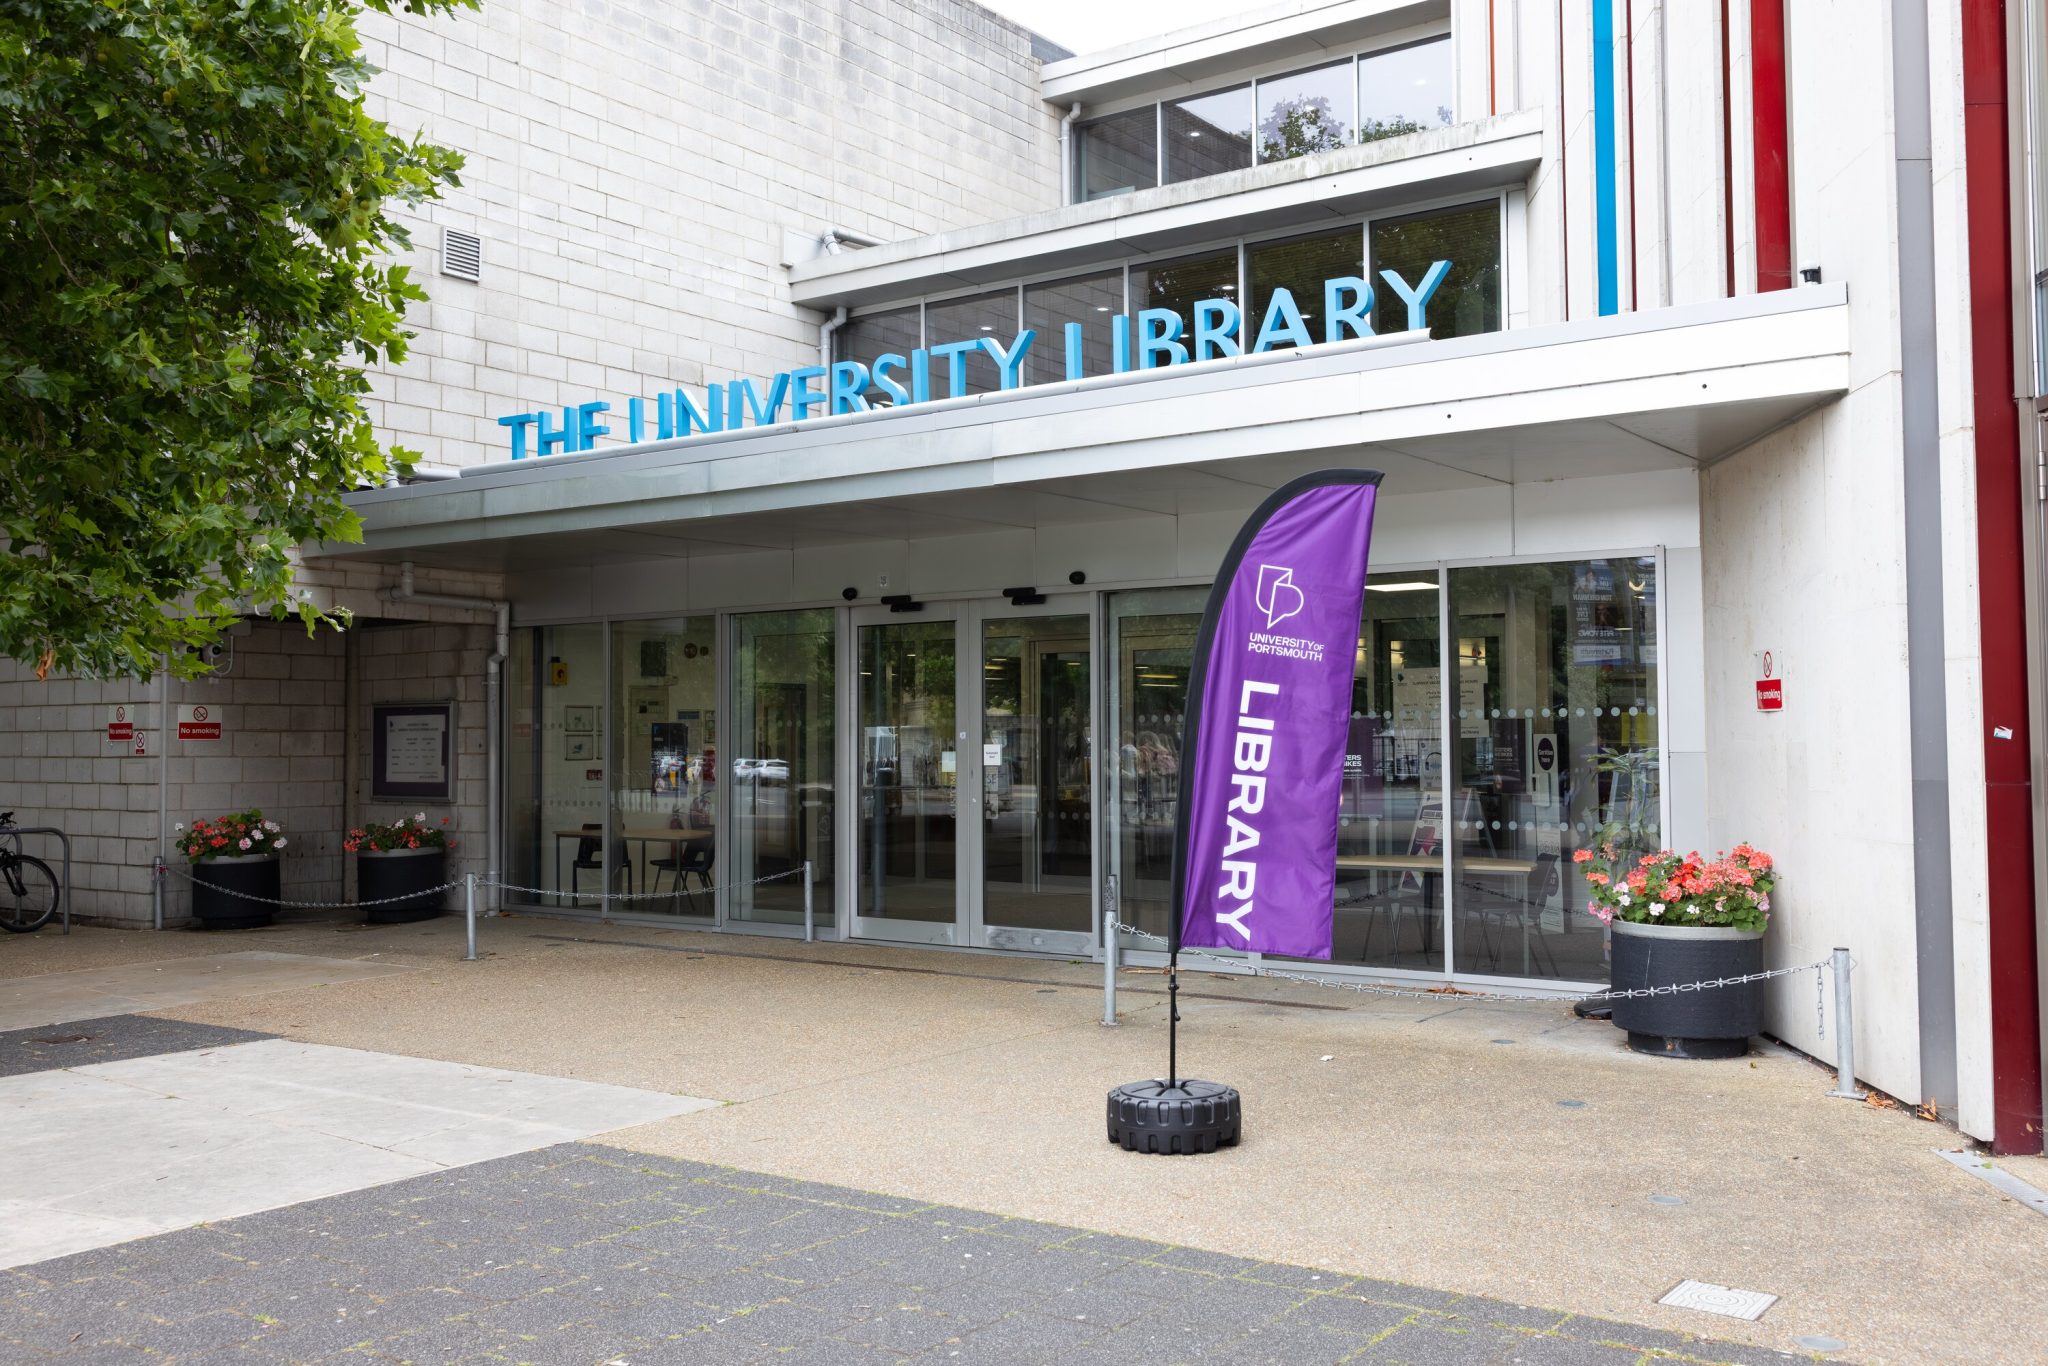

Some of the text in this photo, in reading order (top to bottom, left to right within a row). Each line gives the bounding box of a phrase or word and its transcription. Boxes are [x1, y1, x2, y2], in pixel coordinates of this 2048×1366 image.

[498, 259, 1453, 460] THE UNIVERSITY LIBRARY
[1248, 642, 1323, 662] PORTSMOUTH
[1249, 632, 1325, 652] UNIVERSITY OF
[1763, 688, 1781, 701] smoking
[115, 727, 132, 736] smoking
[192, 727, 220, 736] smoking
[1215, 679, 1279, 942] LIBRARY
